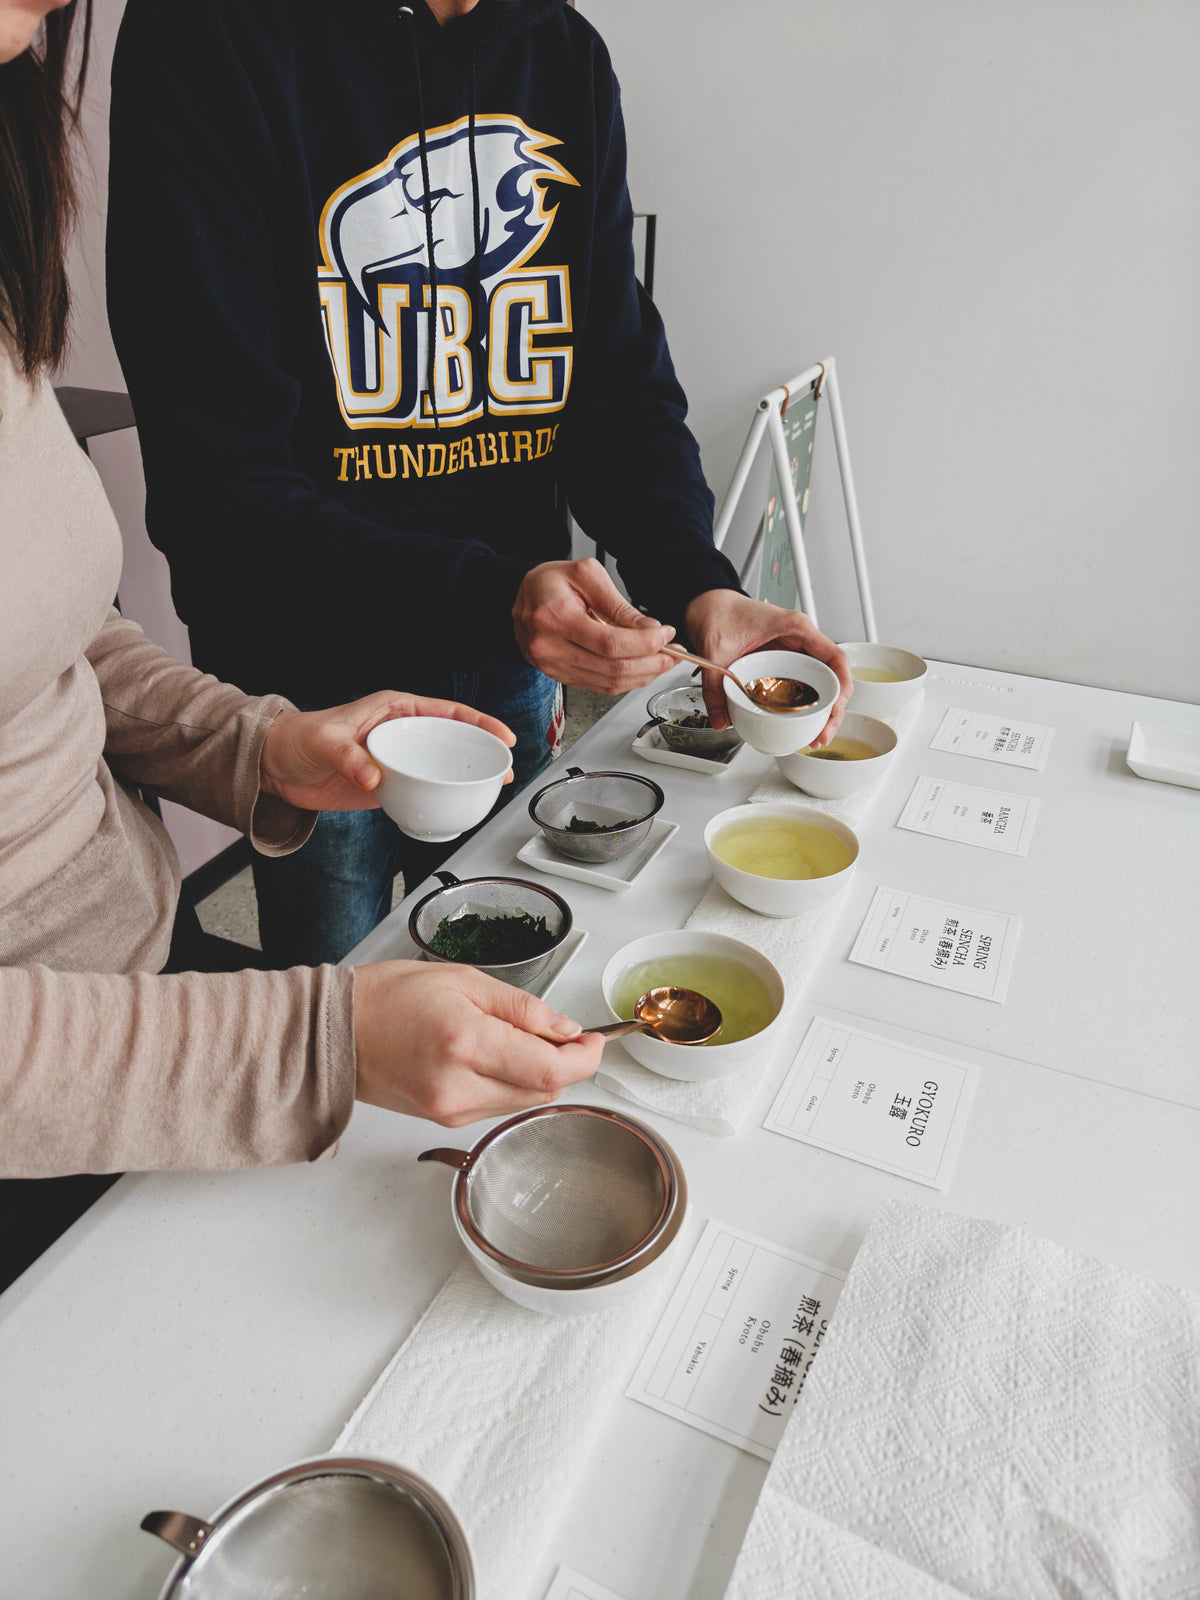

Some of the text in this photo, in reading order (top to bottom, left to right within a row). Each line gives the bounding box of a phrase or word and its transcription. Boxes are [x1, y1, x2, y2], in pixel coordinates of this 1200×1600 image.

[317, 266, 573, 430] UBC
[994, 806, 1011, 834] BANCHA
[952, 928, 974, 966] SENCHA
[973, 934, 993, 970] SPRING
[826, 1047, 839, 1063] Spring
[851, 1080, 865, 1100] Kyoto
[862, 1082, 876, 1105] Obubu
[888, 1093, 912, 1120] 玉露
[905, 1080, 939, 1147] GYOKURO
[721, 1267, 738, 1292] Spring
[738, 1316, 757, 1345] Kyoto
[751, 1319, 771, 1354] Obubu
[685, 1341, 707, 1375] Yabukita
